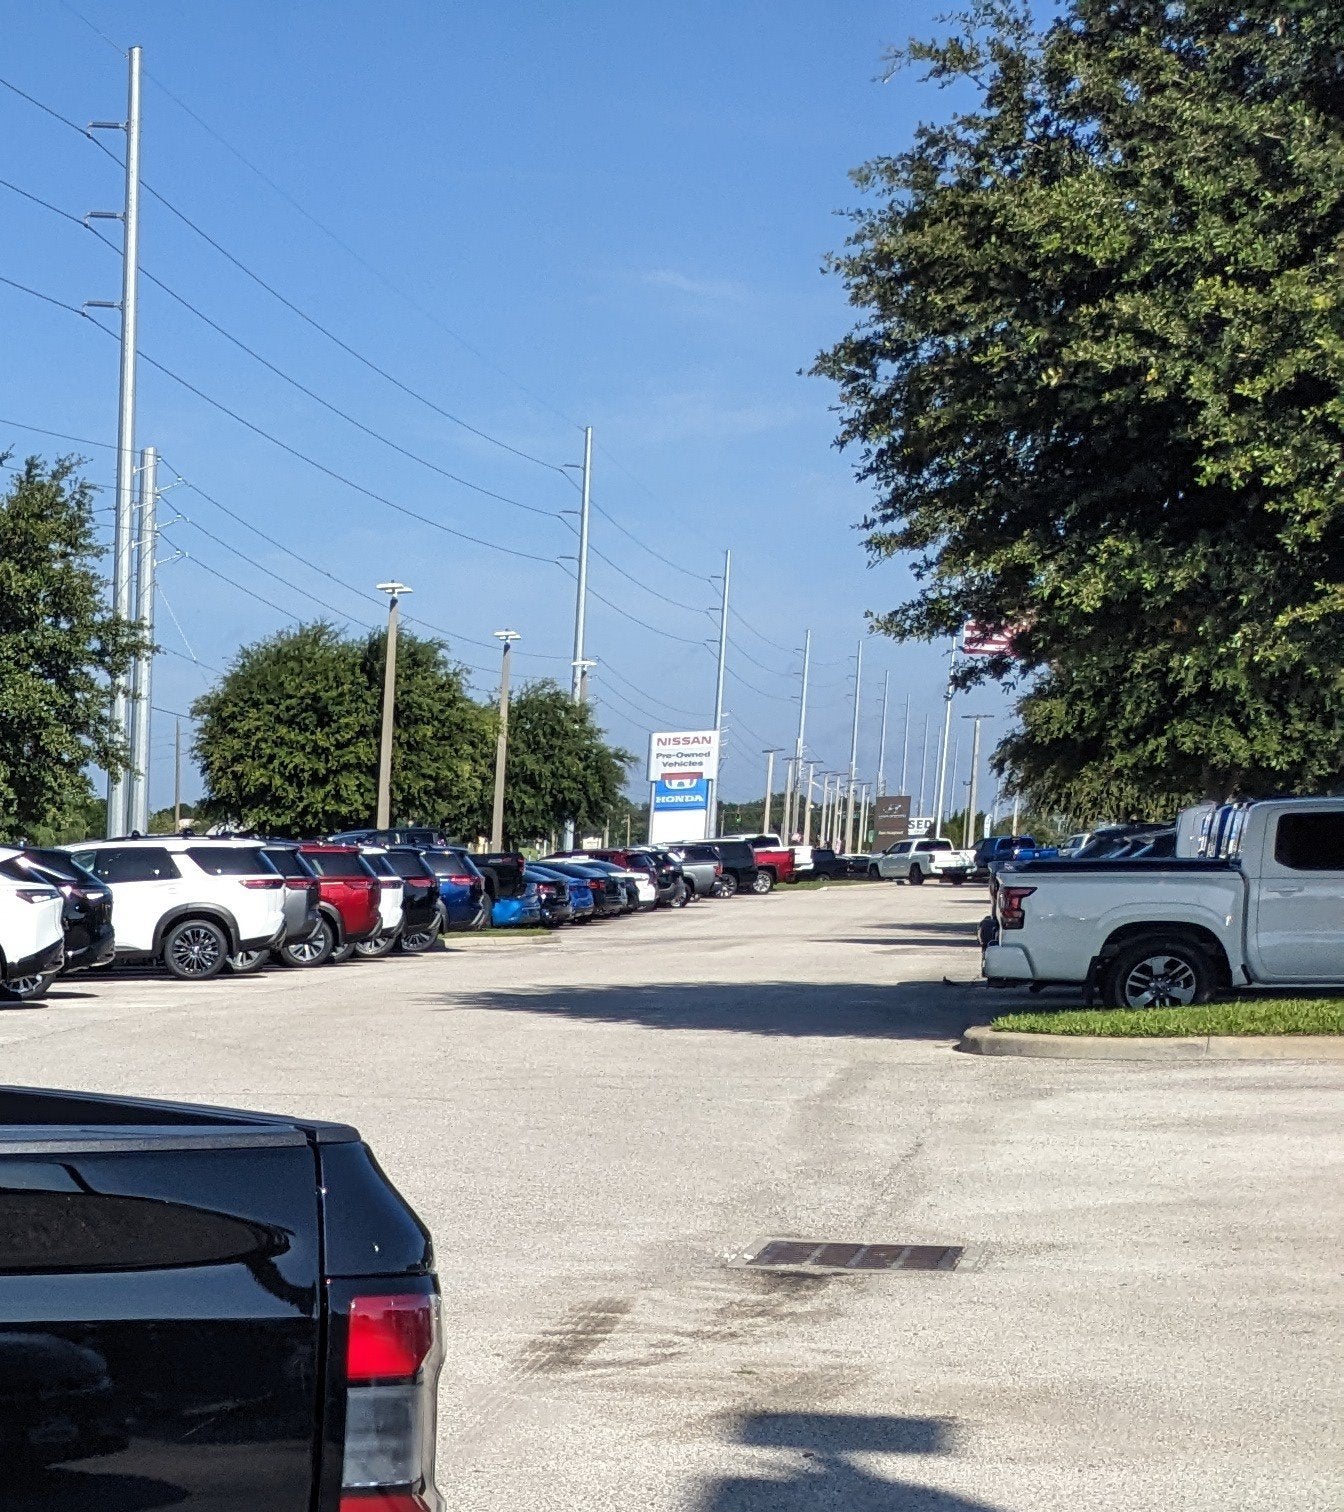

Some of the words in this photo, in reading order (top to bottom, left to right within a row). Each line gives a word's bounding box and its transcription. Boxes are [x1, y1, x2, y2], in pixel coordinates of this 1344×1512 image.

[657, 736, 712, 746] NISSAN
[656, 751, 711, 759] Pre-Owned
[656, 795, 703, 803] HONDA
[908, 819, 932, 830] SED
